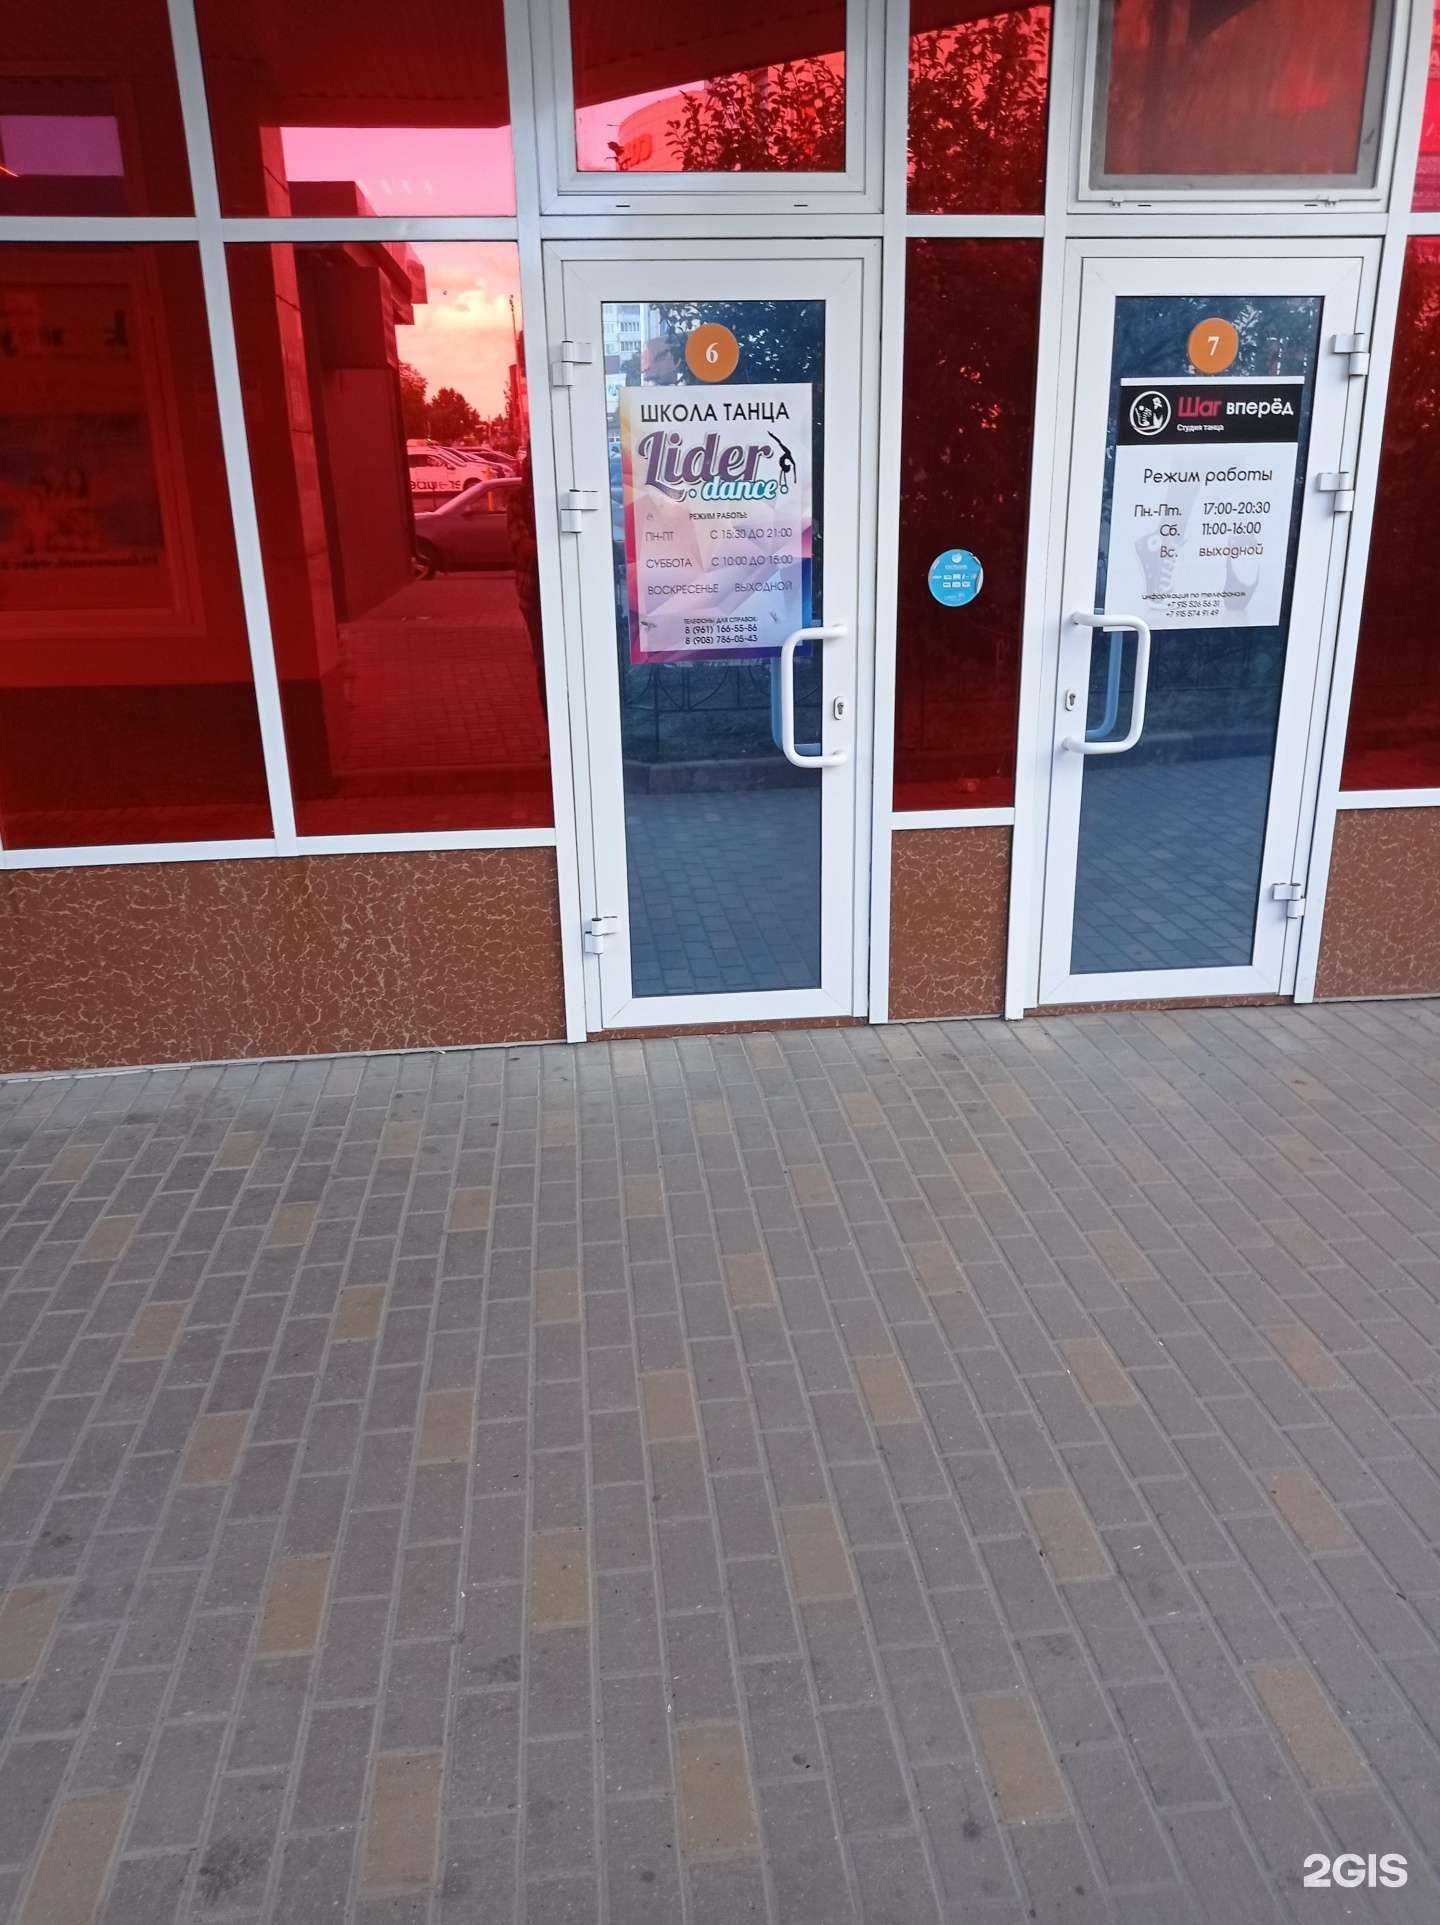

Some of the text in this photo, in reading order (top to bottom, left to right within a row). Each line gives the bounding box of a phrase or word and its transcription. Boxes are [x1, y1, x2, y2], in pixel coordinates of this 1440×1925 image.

[705, 342, 719, 364] 6
[1207, 336, 1220, 356] 7
[640, 402, 790, 423] ШКОЛА ТАНЦА
[1177, 395, 1295, 419] Шаг вперёд
[1176, 423, 1225, 433] Студия танца
[637, 430, 774, 503] Lider
[1143, 467, 1273, 486] Режим работы
[701, 475, 779, 501] dance
[688, 513, 716, 521] РЕЖИМ
[1134, 501, 1271, 518] Пн.-Пт. 17:00-20:30
[646, 527, 793, 543] ПН-ПТ С 15:30 ДО 21:00
[1160, 521, 1262, 537] Сб. 11:00-16:00
[1160, 543, 1264, 559] Вс. выходной
[646, 558, 693, 569] СУББОТА
[711, 557, 719, 567] С
[723, 556, 747, 566] 10:00
[749, 555, 765, 566] ДО
[647, 581, 793, 596] ВОСКРЕСЕНЬЕ ВЫХОДНОЙ
